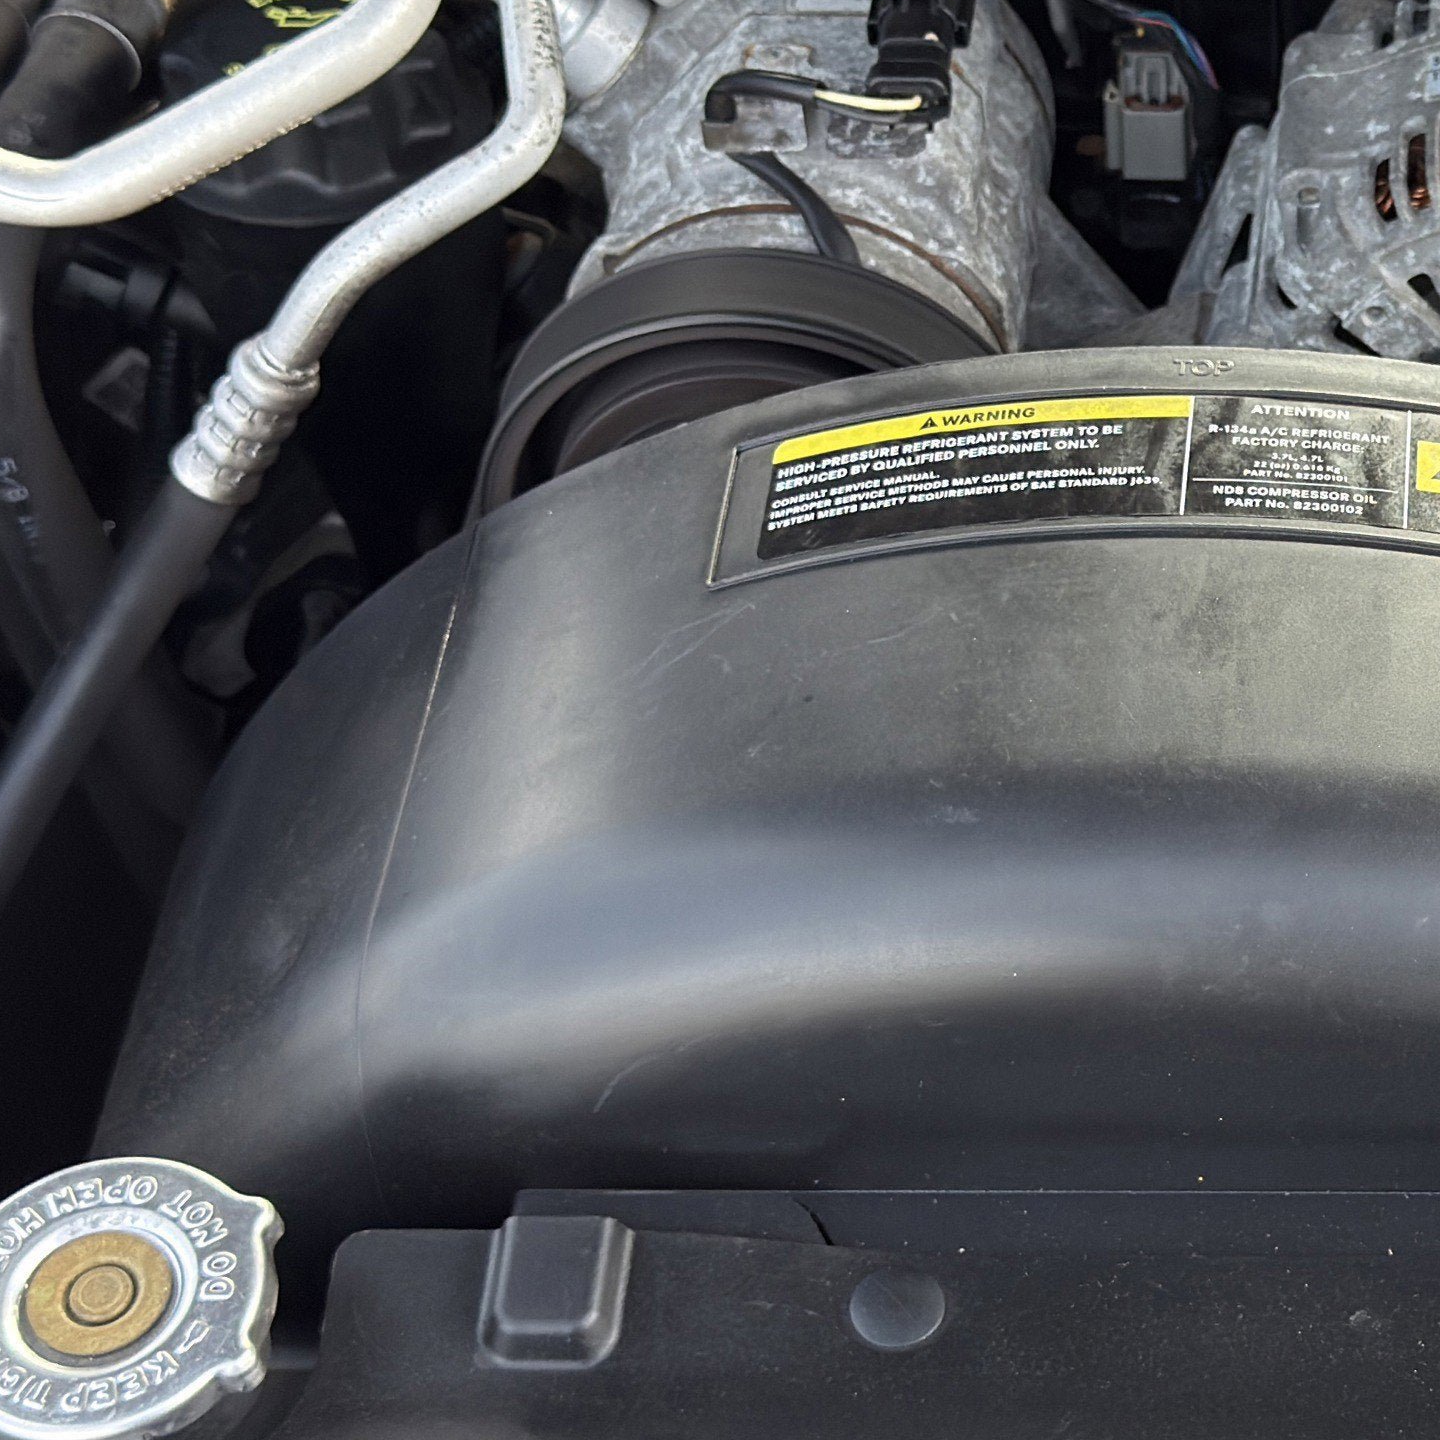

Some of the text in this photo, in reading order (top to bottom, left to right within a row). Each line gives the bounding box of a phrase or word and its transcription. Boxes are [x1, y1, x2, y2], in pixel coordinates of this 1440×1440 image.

[1174, 359, 1235, 376] TOP
[942, 407, 1035, 427] WARNING
[1251, 404, 1350, 420] ATTENTION
[778, 424, 1123, 480] HIGH-PRESSURE REFRIGERANT SYSTEM TO BE
[1209, 424, 1390, 444] R-134a A/C REFRIGERANT
[1232, 436, 1365, 453] FACTORY CHARGE:
[775, 439, 1100, 492] SERVICED BY QUALIFIED PERSONNEL ONLY.
[1243, 469, 1271, 477] PART
[767, 513, 814, 531] SYSTEM
[817, 504, 857, 520] MEETS
[860, 496, 907, 512] SAFETY
[909, 484, 1009, 504] REQUIREMENTS
[1010, 482, 1029, 491] OF
[1031, 480, 1055, 490] SAE
[1059, 477, 1127, 488] STANDARD
[769, 466, 1145, 520] IMPROPER SERVICE METHODS MAY CAUSE PERSONAL INJURY.
[771, 471, 940, 509] CONSULT SERVICE MANUAL.
[1225, 497, 1363, 515] PART No. 82300102
[1247, 486, 1349, 502] COMPRESSOR
[1353, 493, 1377, 504] OIL
[47, 1174, 158, 1219] OPEN
[162, 1189, 228, 1248] NOT
[200, 1251, 236, 1301] DO
[62, 1350, 179, 1413] KEEP
